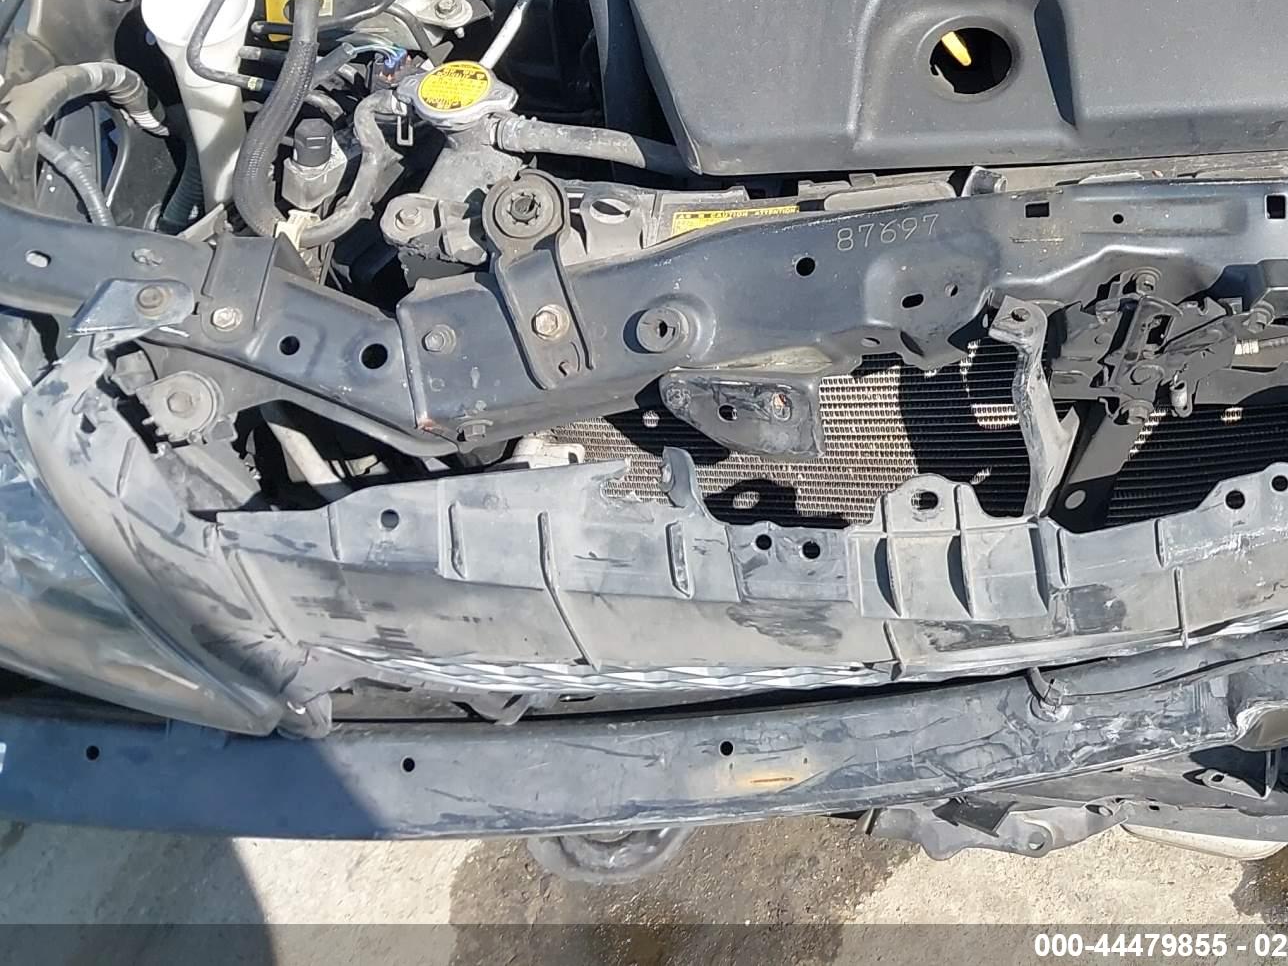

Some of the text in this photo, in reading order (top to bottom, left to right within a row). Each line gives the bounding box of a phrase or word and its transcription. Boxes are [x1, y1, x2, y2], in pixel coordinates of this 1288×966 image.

[710, 207, 797, 219] CAUTION ATTENTION
[836, 213, 940, 251] 87697
